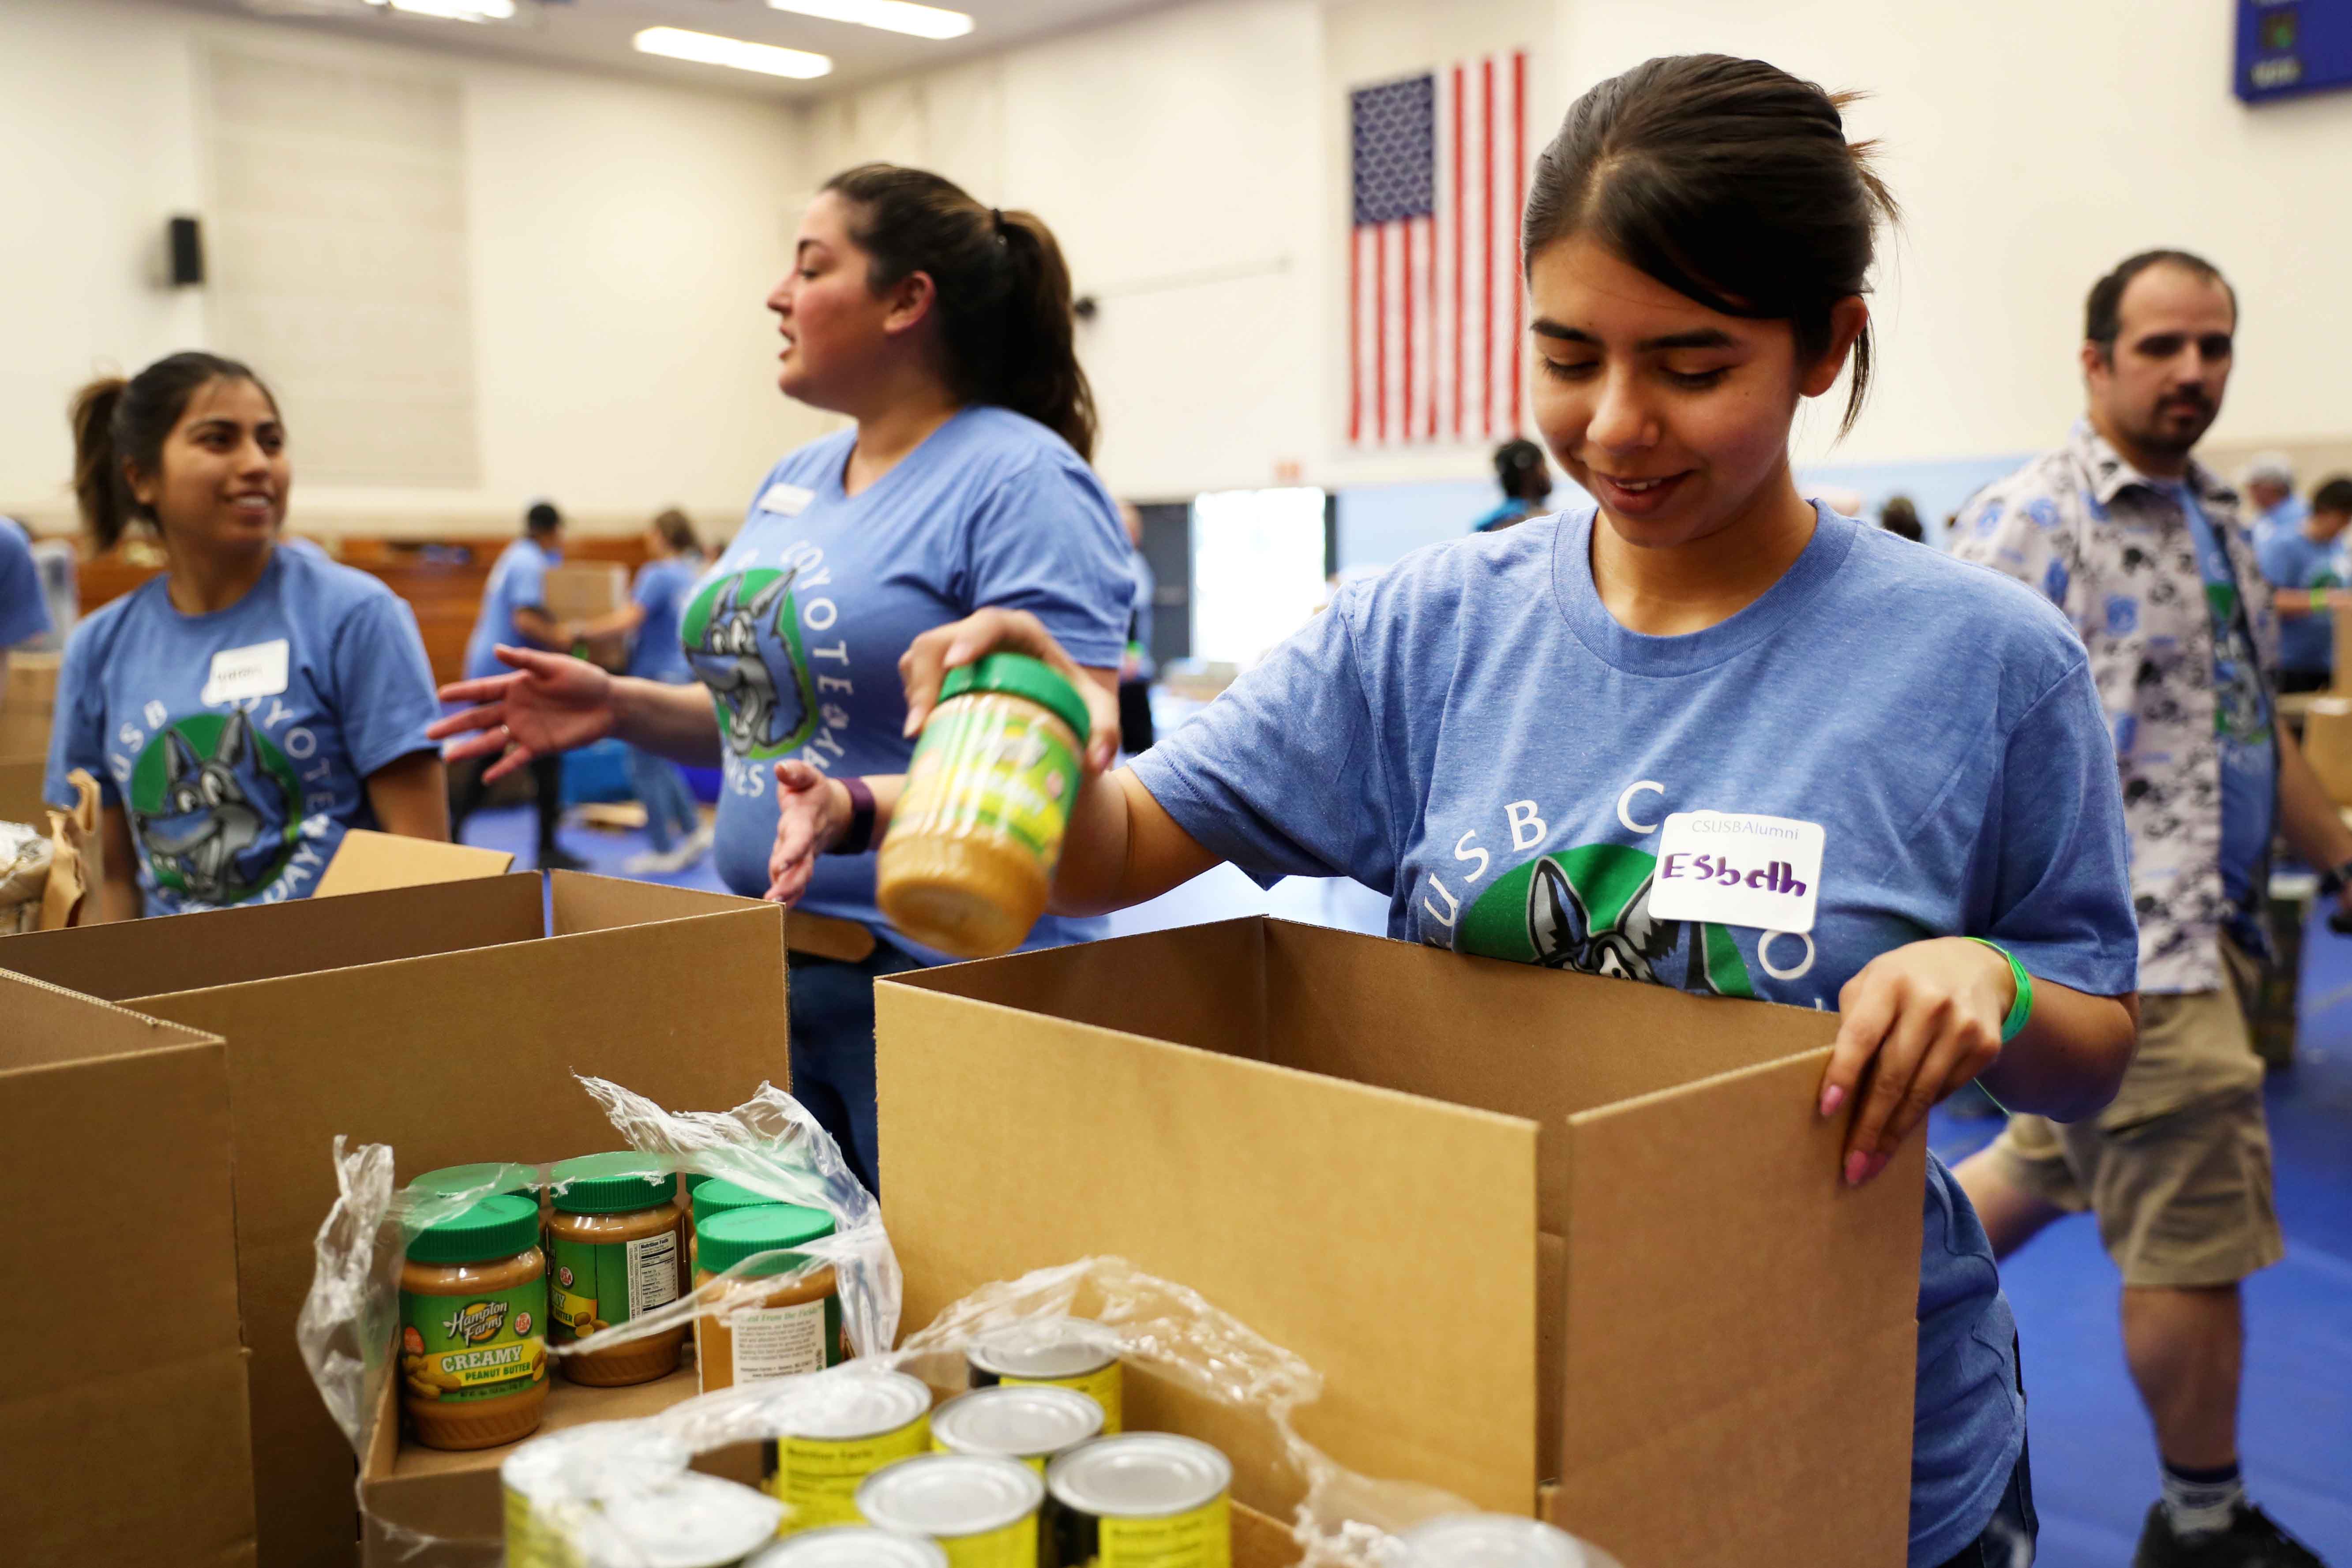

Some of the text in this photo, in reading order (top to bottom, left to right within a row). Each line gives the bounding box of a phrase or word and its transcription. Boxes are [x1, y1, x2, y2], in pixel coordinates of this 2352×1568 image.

[780, 540, 853, 696] COYOTE
[1424, 799, 1546, 948] USB
[560, 1270, 572, 1282] USA
[443, 1302, 507, 1338] Hampton
[463, 1315, 503, 1347] Farms
[515, 1317, 531, 1328] USA
[442, 1345, 522, 1373] CREAMY
[465, 1362, 531, 1380] PEANUT BUTTER
